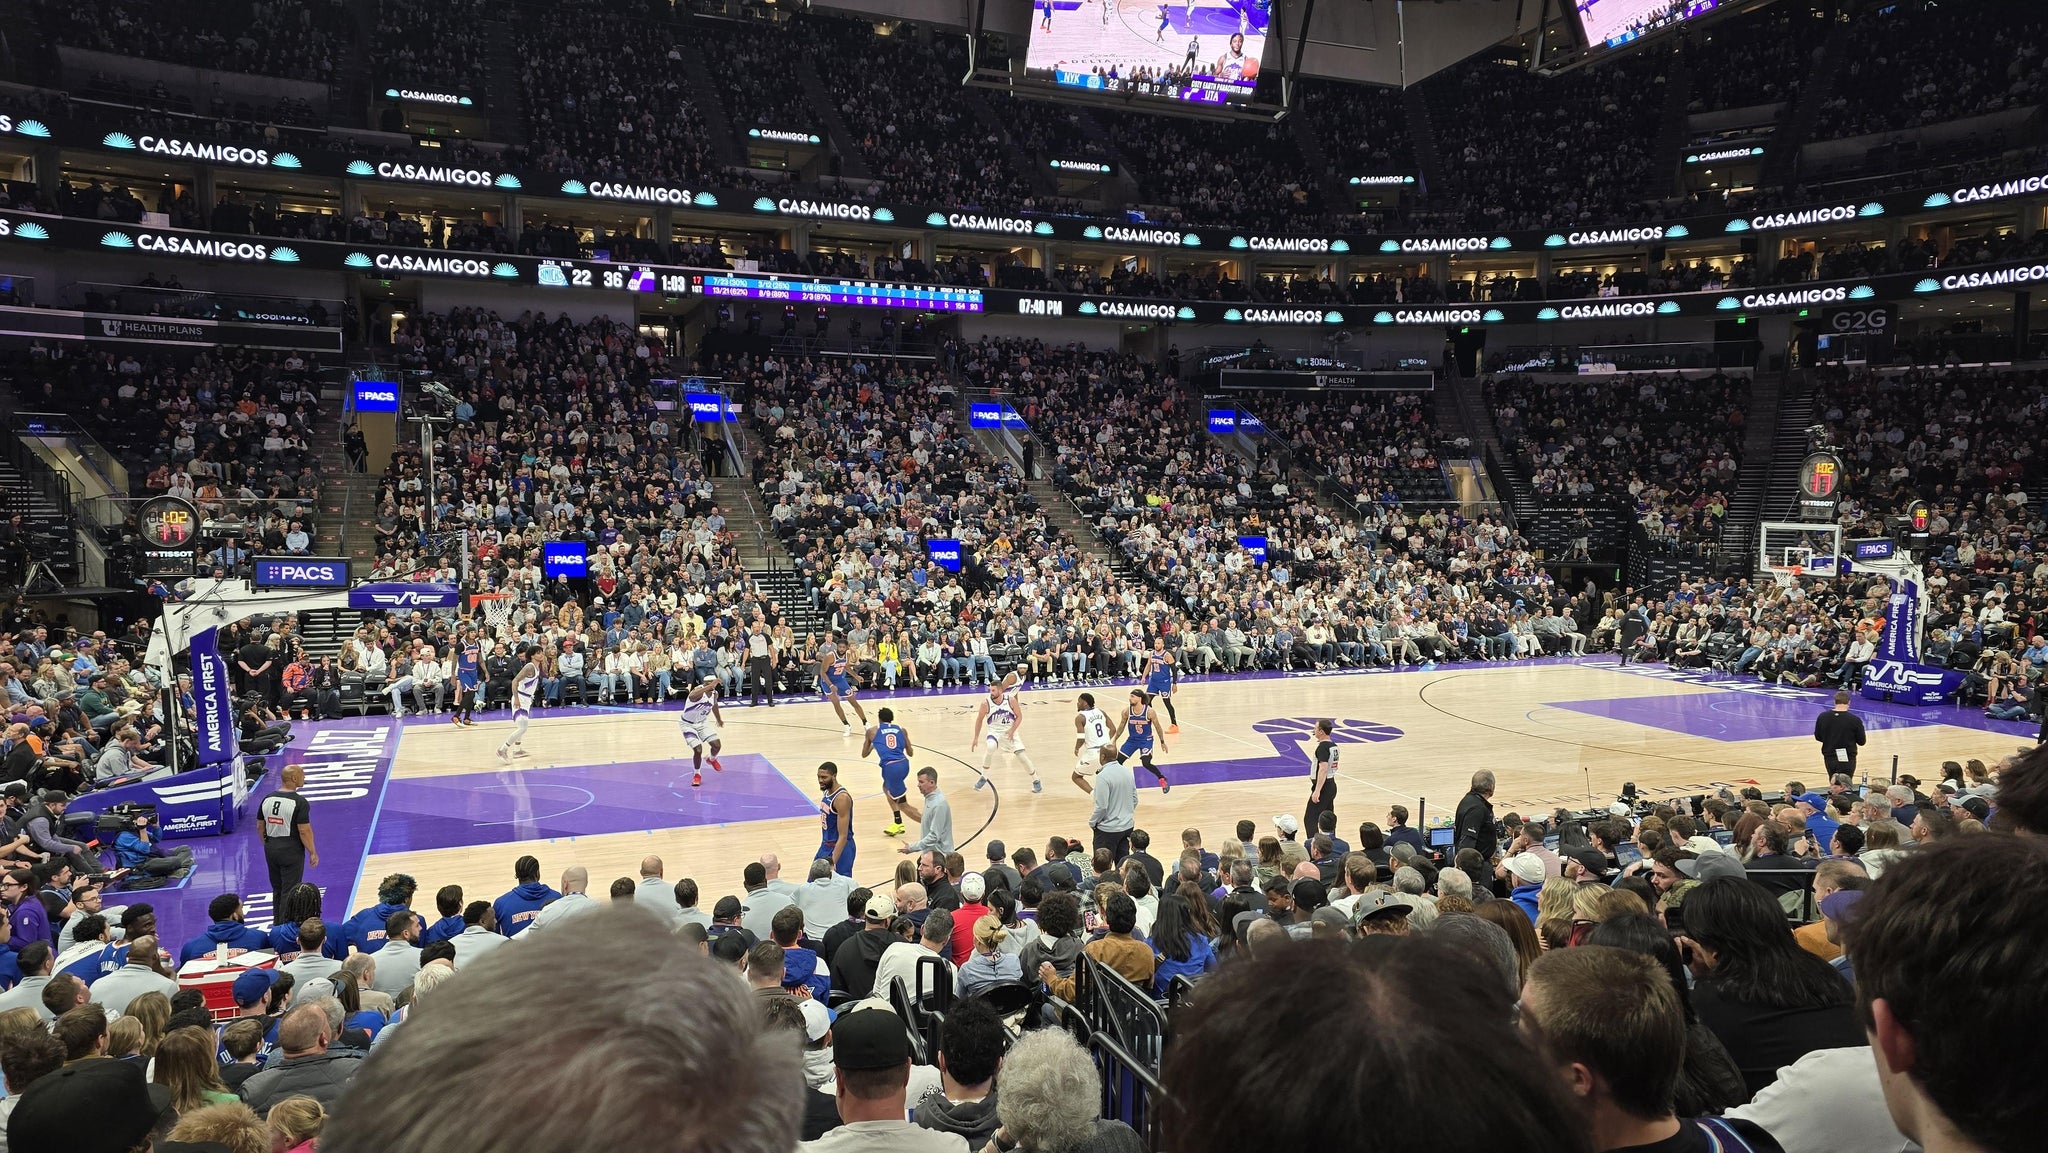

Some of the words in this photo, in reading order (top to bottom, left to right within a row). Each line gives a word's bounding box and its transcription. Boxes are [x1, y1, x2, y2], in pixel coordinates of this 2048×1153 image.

[1063, 72, 1080, 84] NYK
[1109, 79, 1119, 88] 22
[401, 90, 458, 104] CASAMIGOS
[761, 129, 808, 143] CASAMIGOS
[139, 136, 268, 165] CASAMIGOS
[1700, 149, 1750, 161] CASAMIGOS
[1061, 160, 1099, 171] CASAMIGOS
[378, 163, 491, 186] CASAMIGOS
[1361, 175, 1403, 184] CASAMIGOS
[590, 182, 691, 204] CASAMIGOS
[779, 199, 870, 219] CASAMIGOS
[1752, 205, 1856, 229] CASAMIGOS
[950, 214, 1032, 233] CASAMIGOS
[1104, 227, 1180, 245] CASAMIGOS
[1569, 227, 1663, 244] CASAMIGOS
[137, 234, 266, 260] CASAMIGOS
[1250, 237, 1328, 251] CASAMIGOS
[1402, 238, 1488, 251] CASAMIGOS
[376, 254, 489, 275] CASAMIGOS
[540, 268, 564, 280] KNICKS
[572, 269, 592, 286] 22
[603, 271, 623, 287] 36
[692, 276, 701, 284] 17
[661, 275, 685, 292] 1:03
[691, 285, 702, 293] 1ST
[1743, 287, 1846, 308] CASAMIGOS
[1018, 298, 1045, 315] 07:40
[1047, 300, 1063, 315] PM
[1100, 302, 1175, 318] CASAMIGOS
[1561, 302, 1654, 319] CASAMIGOS
[1244, 310, 1322, 323] CASAMIGOS
[1396, 310, 1480, 323] CASAMIGOS
[1833, 309, 1886, 330] G2G
[125, 323, 166, 333] HEALTH
[169, 325, 203, 335] PLANS
[1815, 462, 1835, 474] 1:02
[1812, 474, 1832, 494] 17
[163, 511, 188, 524] 1:02
[161, 524, 185, 541] 17
[1865, 544, 1888, 554] PACS
[1891, 596, 1902, 619] FIRST
[1888, 620, 1898, 656] AMERICA
[1905, 622, 1914, 658] AMERICA
[203, 653, 214, 690] FIRST
[1865, 680, 1893, 689] AMERICA
[1893, 683, 1912, 692] FIRST
[208, 691, 221, 751] AMERICA
[1001, 717, 1011, 725] 42
[1095, 723, 1104, 738] 8
[303, 727, 390, 758] JAZZ
[886, 734, 897, 749] 8
[296, 759, 378, 802] UTAH
[272, 801, 281, 815] 8
[163, 822, 195, 831] AMERICA
[196, 819, 217, 828] FIRST
[511, 912, 530, 924] NEW
